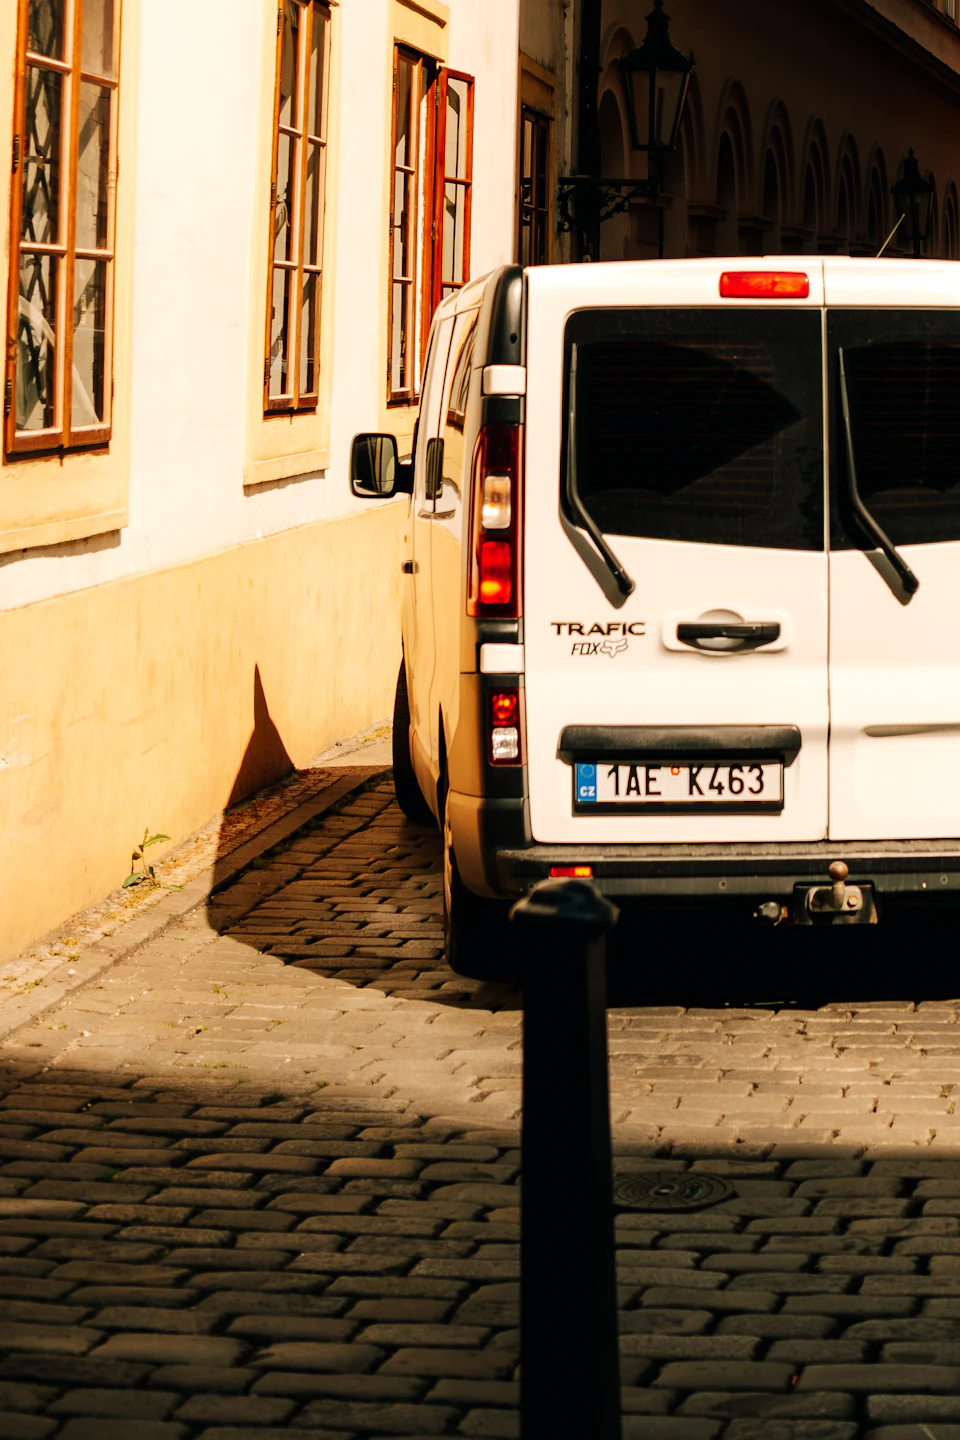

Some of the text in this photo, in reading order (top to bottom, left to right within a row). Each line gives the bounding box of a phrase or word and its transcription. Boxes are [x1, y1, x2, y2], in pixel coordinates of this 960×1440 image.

[550, 621, 645, 636] TRAFIC
[571, 642, 601, 656] FOX
[607, 764, 764, 796] 1AE K463
[580, 785, 596, 797] CZ
